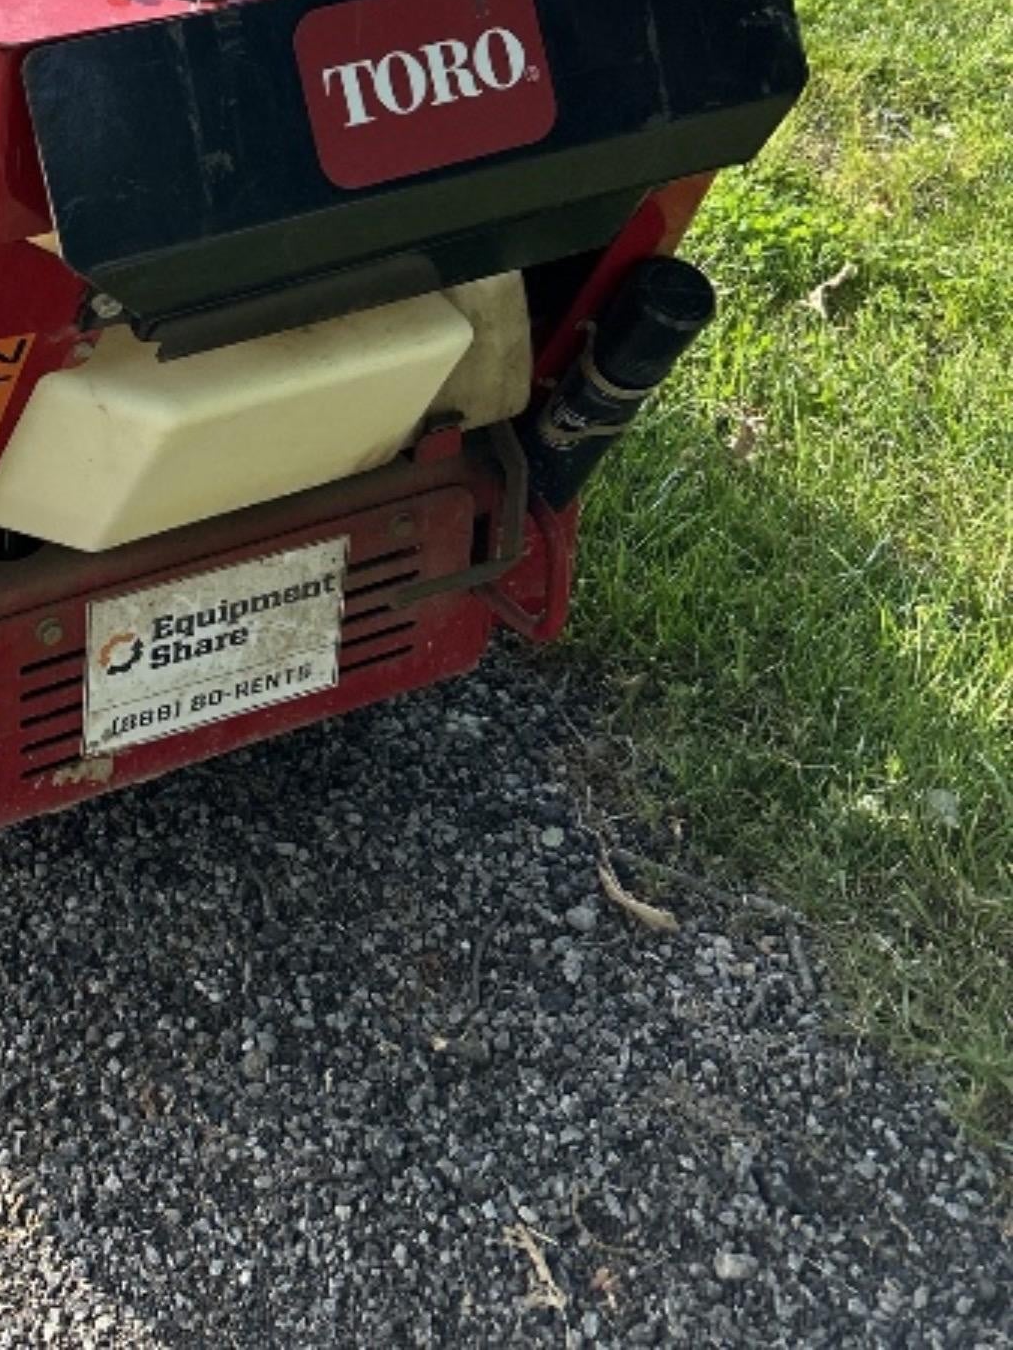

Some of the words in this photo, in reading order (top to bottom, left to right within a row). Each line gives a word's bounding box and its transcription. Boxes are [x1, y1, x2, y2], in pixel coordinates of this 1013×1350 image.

[322, 26, 526, 129] TORO
[151, 572, 337, 642] Equipment
[148, 626, 250, 670] Share
[111, 700, 182, 735] (888)
